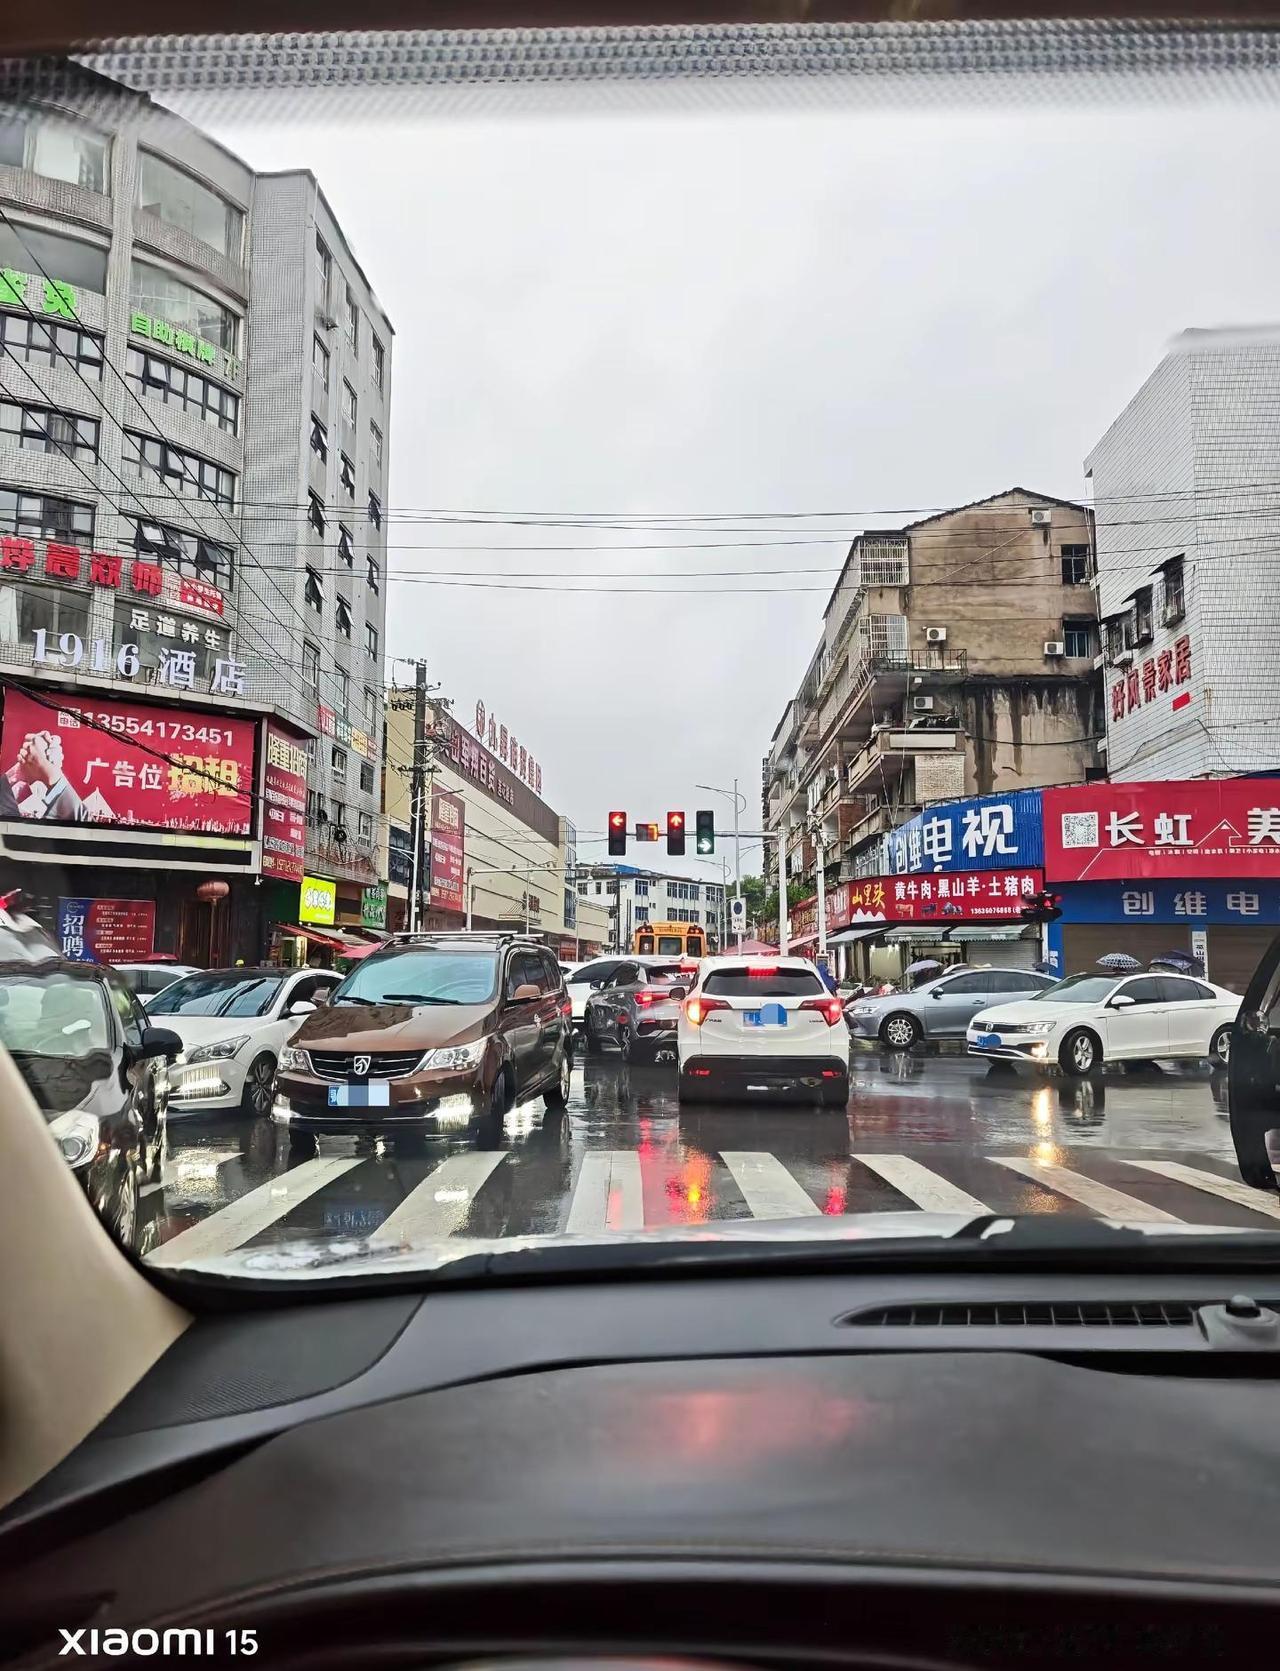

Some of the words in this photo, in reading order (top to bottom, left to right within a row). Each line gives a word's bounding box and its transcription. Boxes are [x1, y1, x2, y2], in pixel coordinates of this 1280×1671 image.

[129, 608, 221, 652] 足道养生
[1112, 634, 1192, 722] 好风景家居
[83, 710, 234, 747] 13554173451
[895, 804, 1019, 874] 创维电视
[1105, 810, 1194, 847] 长虹
[62, 914, 84, 957] 招聘
